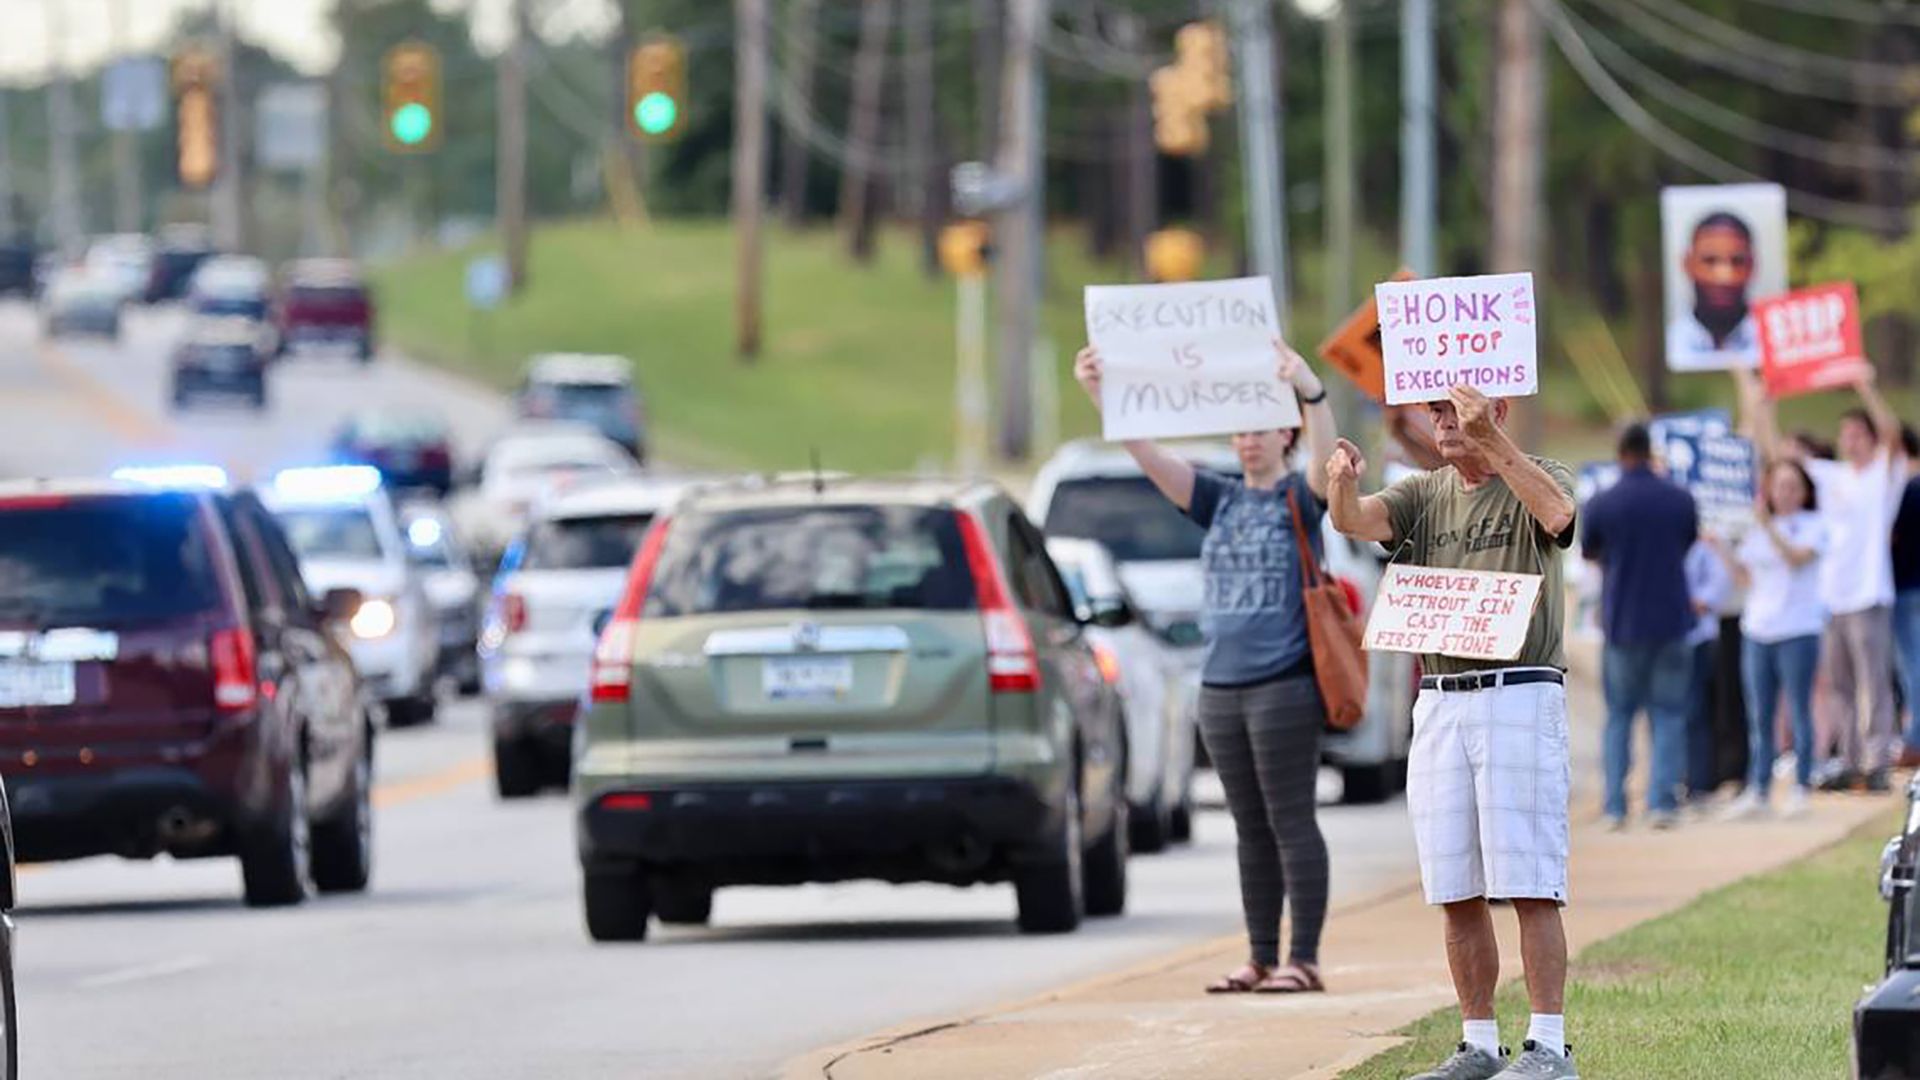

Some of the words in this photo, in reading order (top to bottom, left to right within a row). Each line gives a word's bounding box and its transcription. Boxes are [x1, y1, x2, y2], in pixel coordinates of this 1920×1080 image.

[1094, 297, 1267, 333] EXECUTION
[1403, 292, 1502, 325] HONK
[1171, 343, 1203, 369] IS
[1402, 337, 1427, 356] TO
[1437, 330, 1502, 357] STOP
[1394, 364, 1526, 391] EXECUTIONS
[1120, 380, 1281, 417] MURDER
[1395, 573, 1480, 593] WHOEVER
[1493, 578, 1522, 595] IS
[1387, 593, 1470, 612] WITHOUT
[1476, 598, 1515, 616] SIN
[1406, 613, 1452, 630] CAST
[1463, 616, 1493, 634] THE
[1374, 631, 1428, 647] FIRST
[1437, 634, 1498, 655] STONE
